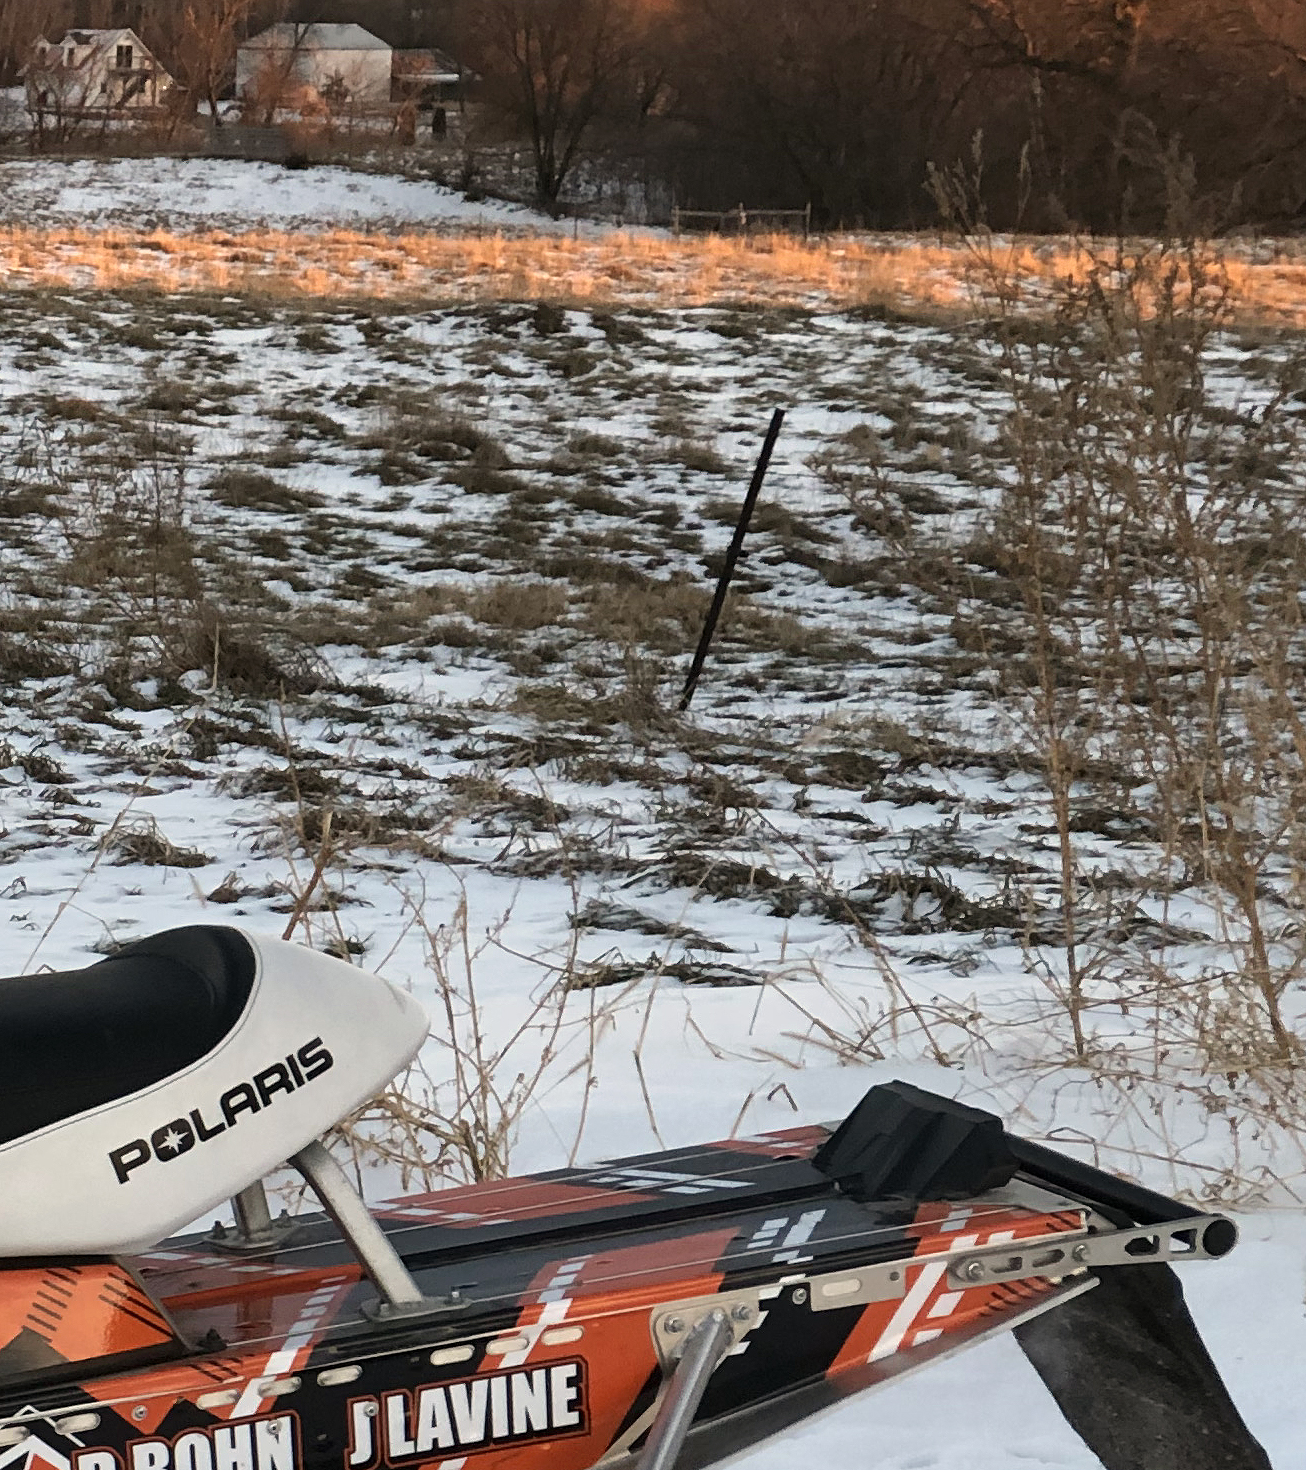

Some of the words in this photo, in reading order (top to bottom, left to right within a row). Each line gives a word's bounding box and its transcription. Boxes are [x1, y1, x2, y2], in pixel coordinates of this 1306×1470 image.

[108, 1037, 334, 1184] POLARIS
[349, 1400, 378, 1466] J
[386, 1364, 581, 1458] LAVINE
